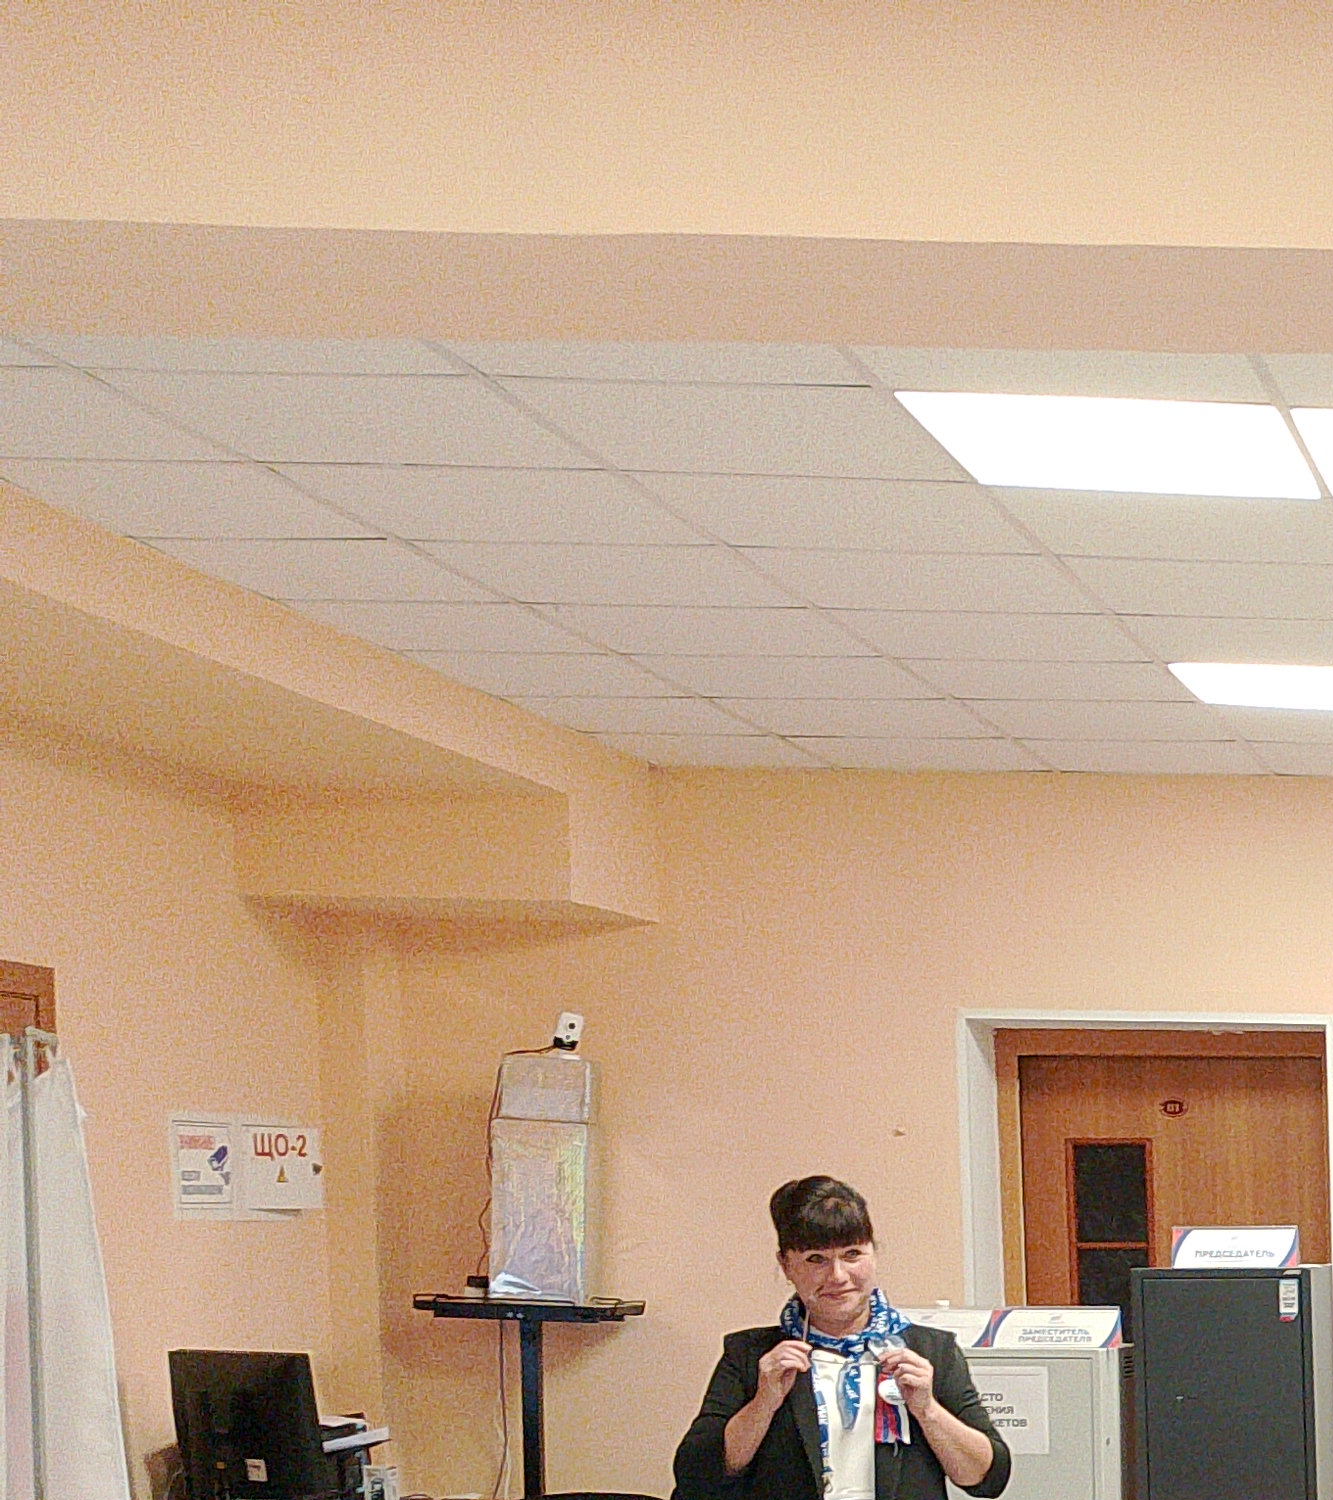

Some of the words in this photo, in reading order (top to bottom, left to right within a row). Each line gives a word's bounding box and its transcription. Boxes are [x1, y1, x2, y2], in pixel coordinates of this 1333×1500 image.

[253, 1132, 308, 1161] ЩО-2
[1194, 1249, 1276, 1259] ПРЕДСЕДАТЕЛЬ
[1021, 1328, 1090, 1336] ЗАМЕСТИТЕЛЬ
[1017, 1336, 1093, 1344] ПРЕДСЕДАТЕЛЯ
[978, 1393, 1004, 1402] СТО
[983, 1405, 1015, 1415] ЕНИЯ
[992, 1418, 1028, 1428] КЕТОВ
